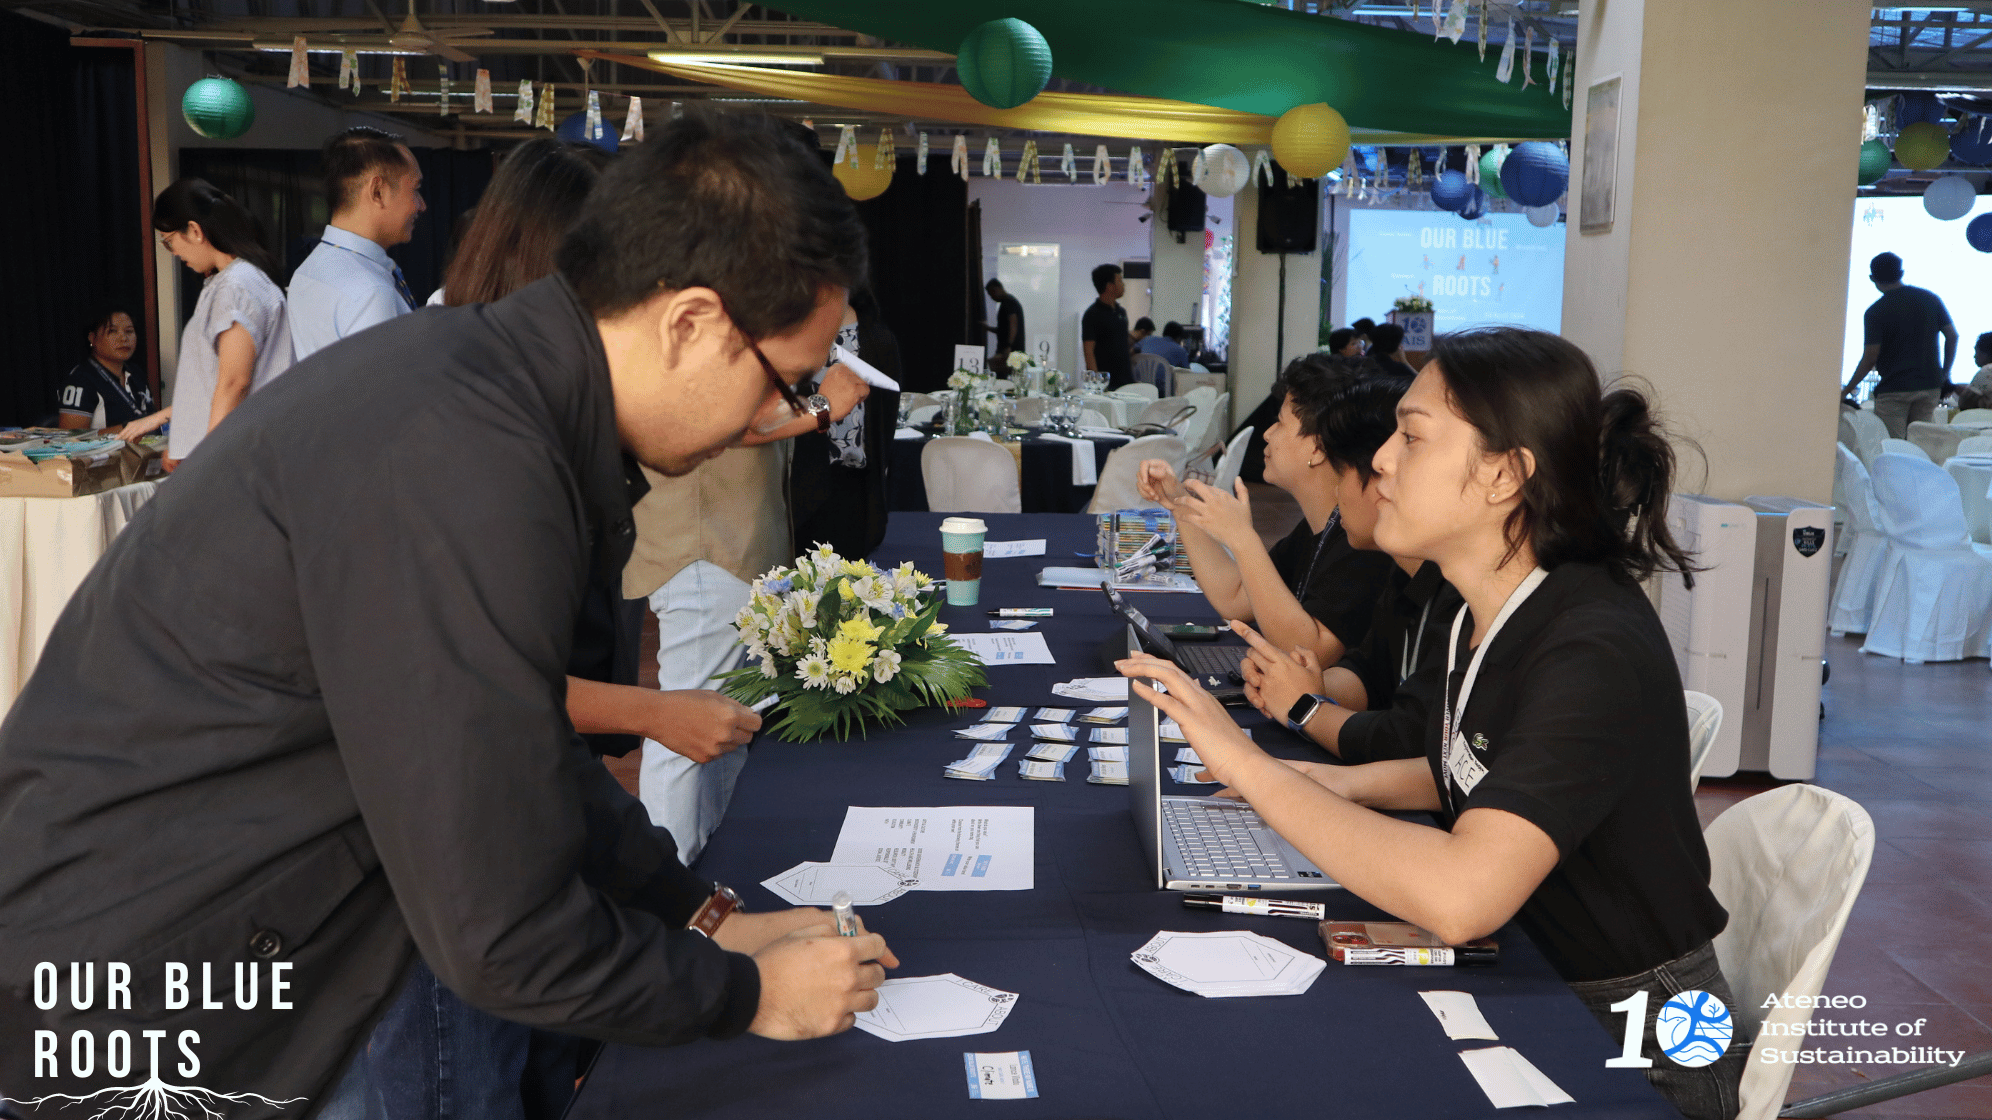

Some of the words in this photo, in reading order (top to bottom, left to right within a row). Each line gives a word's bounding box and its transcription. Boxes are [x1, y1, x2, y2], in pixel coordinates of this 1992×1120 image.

[1421, 227, 1456, 248] OUR
[1463, 228, 1508, 250] BLUE
[1433, 275, 1491, 296] ROOTS
[1039, 340, 1050, 360] 9
[959, 357, 979, 374] 13
[62, 385, 84, 408] 01
[1455, 753, 1476, 788] ACE
[1144, 936, 1167, 953] ABOUT
[986, 1006, 1008, 1026] ABOUT
